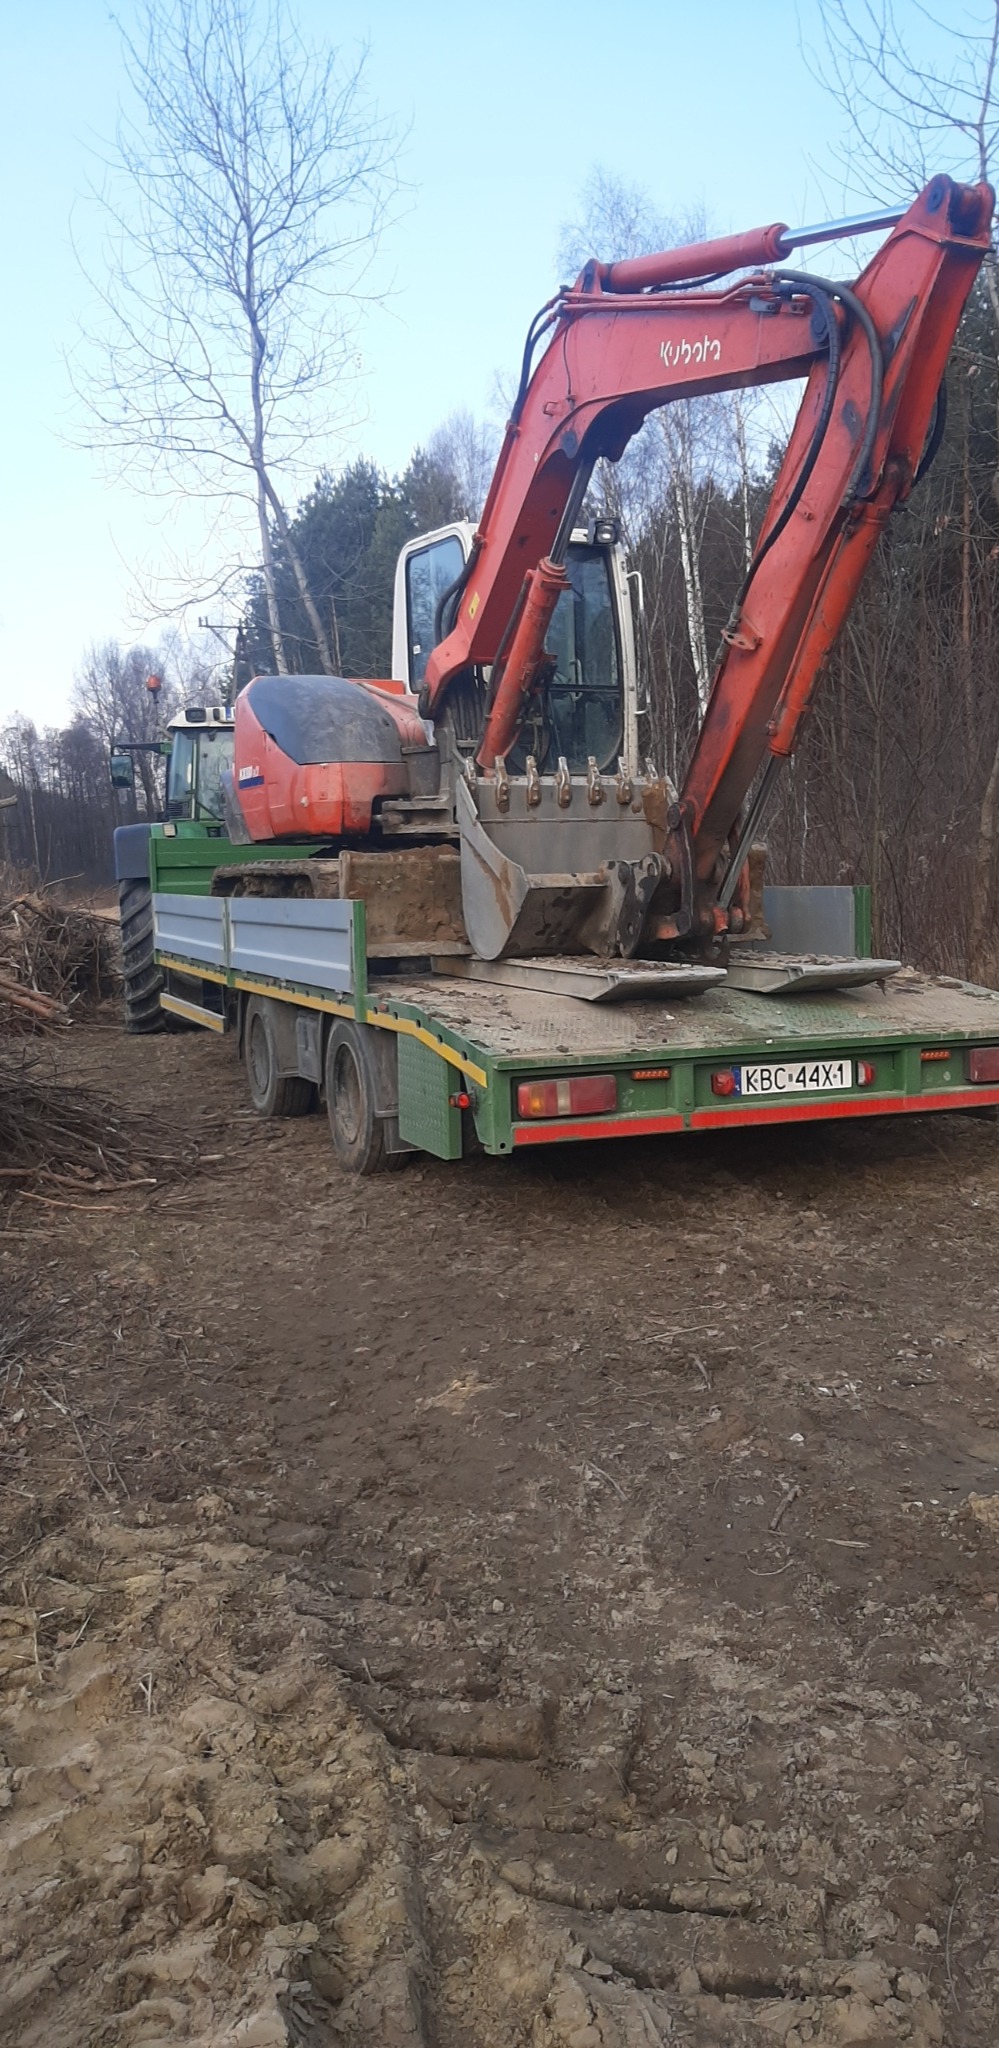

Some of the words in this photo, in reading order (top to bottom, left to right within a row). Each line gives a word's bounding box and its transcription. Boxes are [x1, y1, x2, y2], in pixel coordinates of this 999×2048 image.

[660, 335, 721, 367] Kubota
[746, 1067, 786, 1092] KBC
[795, 1063, 844, 1088] 44X1
